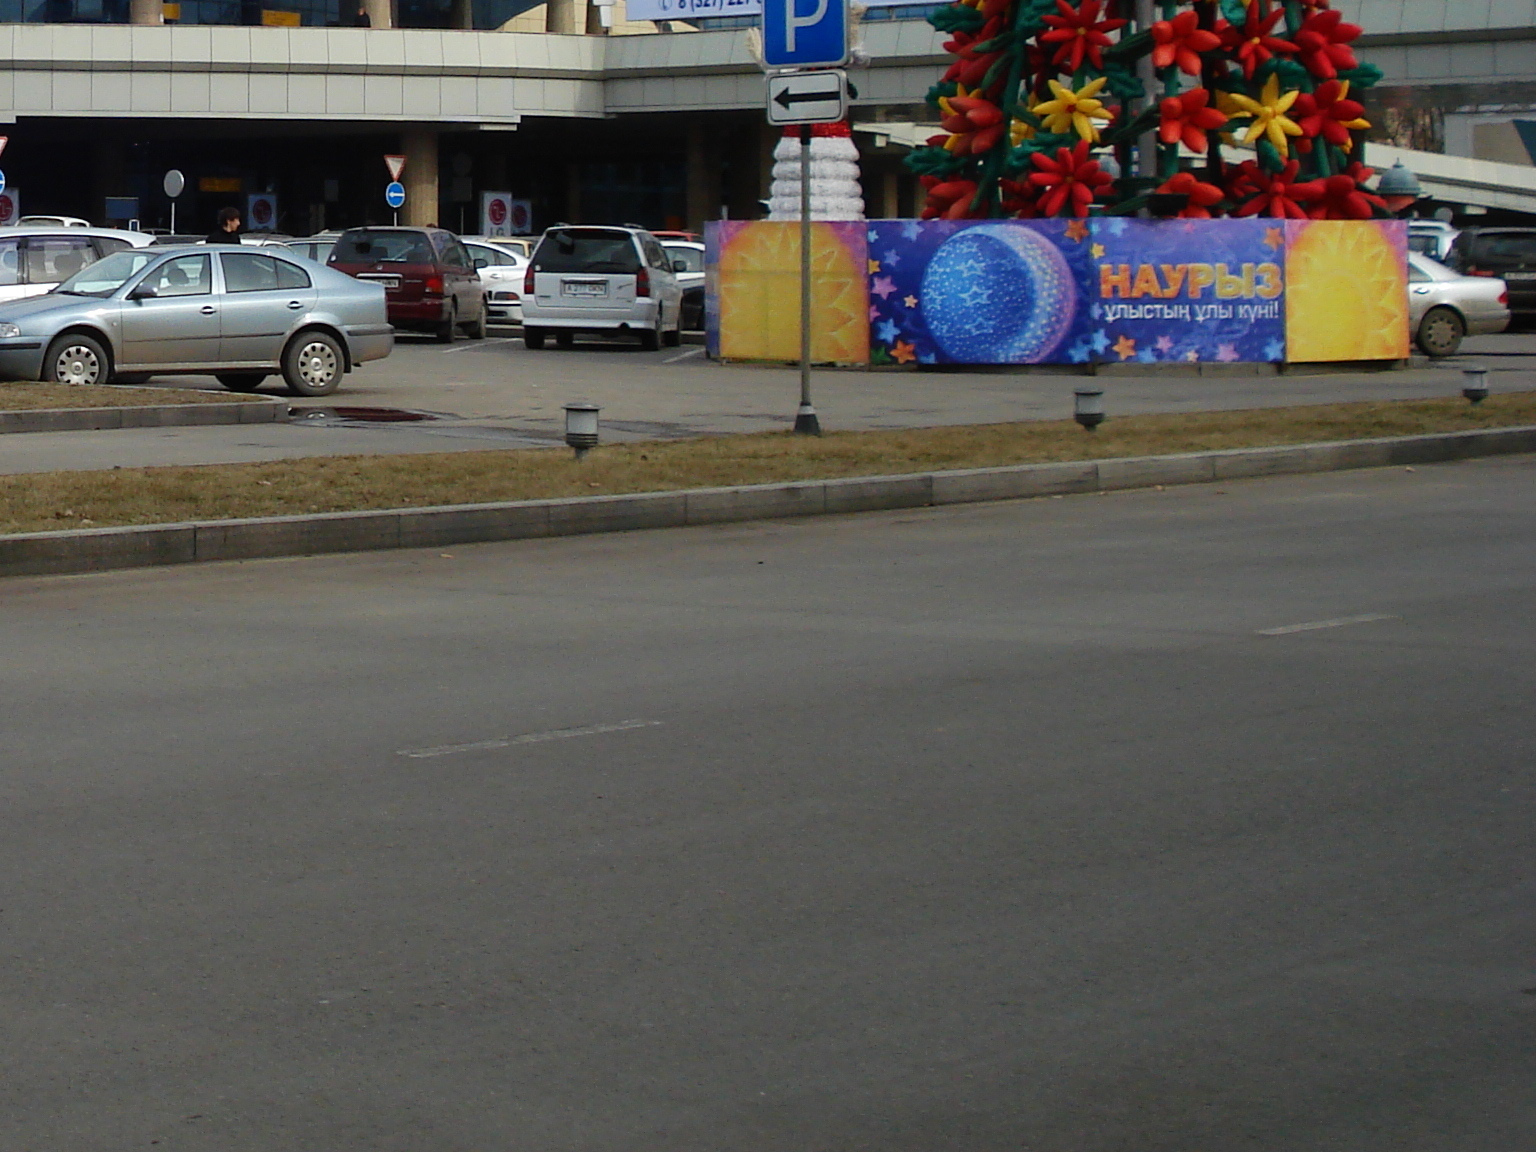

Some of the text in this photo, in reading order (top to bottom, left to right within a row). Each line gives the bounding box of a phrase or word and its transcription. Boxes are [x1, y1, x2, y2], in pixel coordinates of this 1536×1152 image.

[1099, 262, 1284, 299] НАУРЫЗ
[1103, 300, 1280, 323] ұлыстың ұлы күні!
